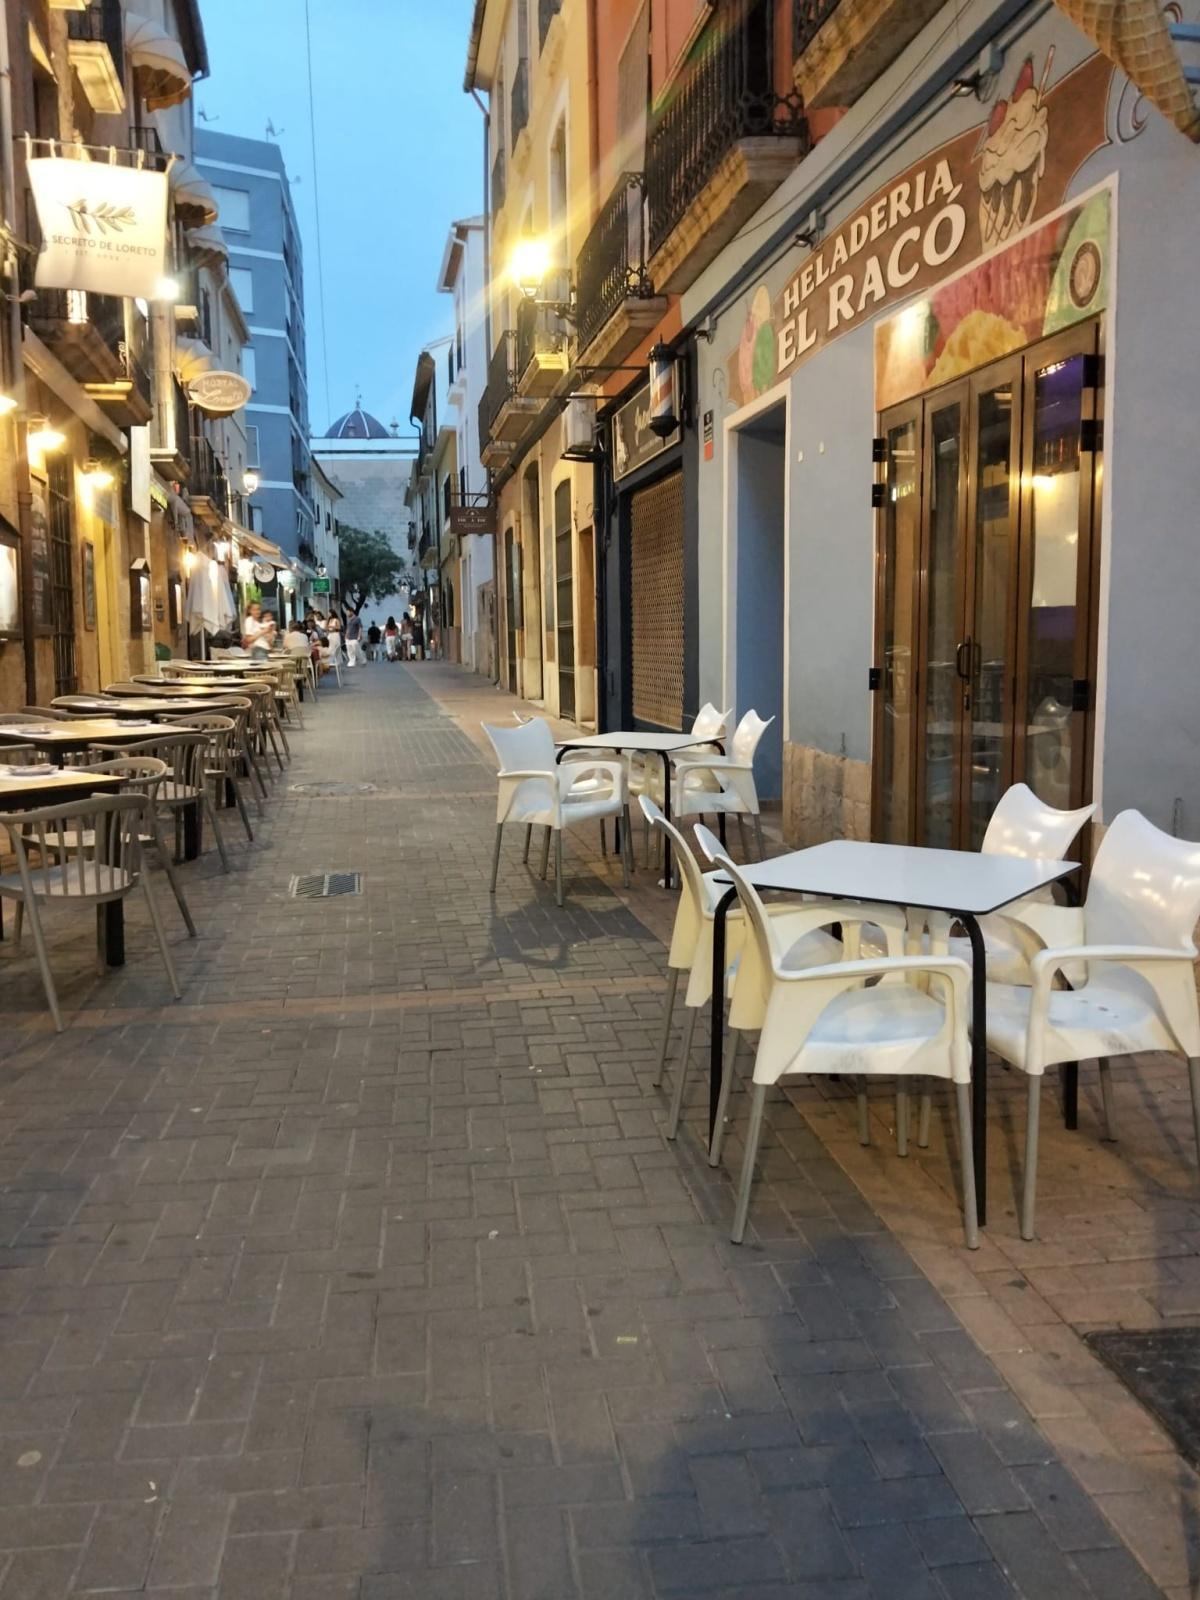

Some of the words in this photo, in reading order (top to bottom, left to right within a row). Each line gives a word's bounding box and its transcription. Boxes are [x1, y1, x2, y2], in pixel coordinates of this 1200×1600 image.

[51, 235, 96, 248] SECRETO
[99, 241, 113, 251] DE
[115, 243, 157, 257] LORETO
[777, 307, 817, 374] EL
[827, 183, 966, 332] RACÓ
[783, 159, 954, 319] HELADERIA
